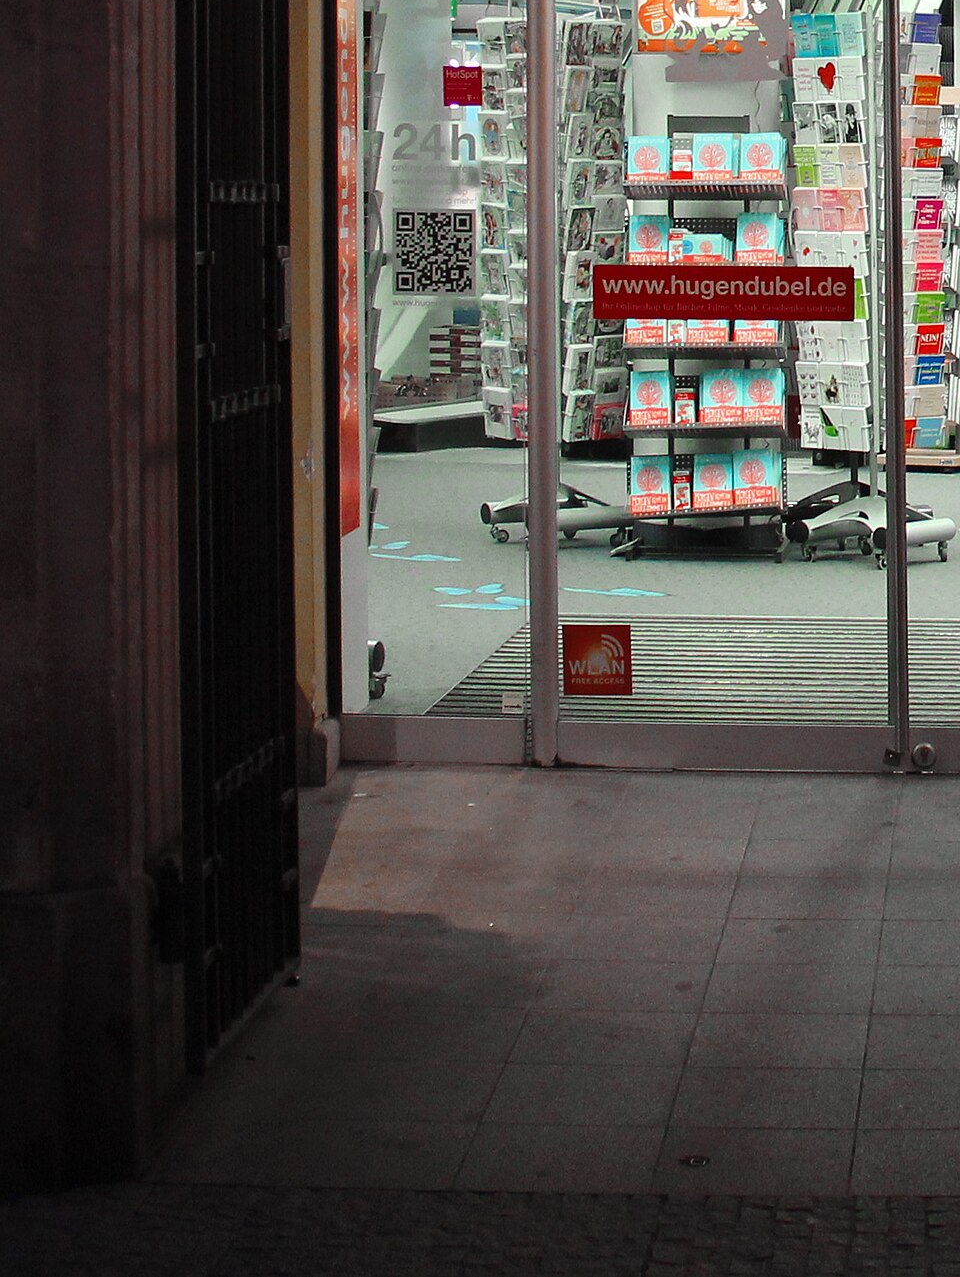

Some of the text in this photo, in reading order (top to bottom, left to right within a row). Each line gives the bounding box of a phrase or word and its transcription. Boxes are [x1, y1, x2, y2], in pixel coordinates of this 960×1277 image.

[445, 69, 479, 81] HotSpot
[392, 122, 477, 161] 24h
[601, 275, 848, 300] www.hugendubel.de
[568, 659, 625, 675] WLAN
